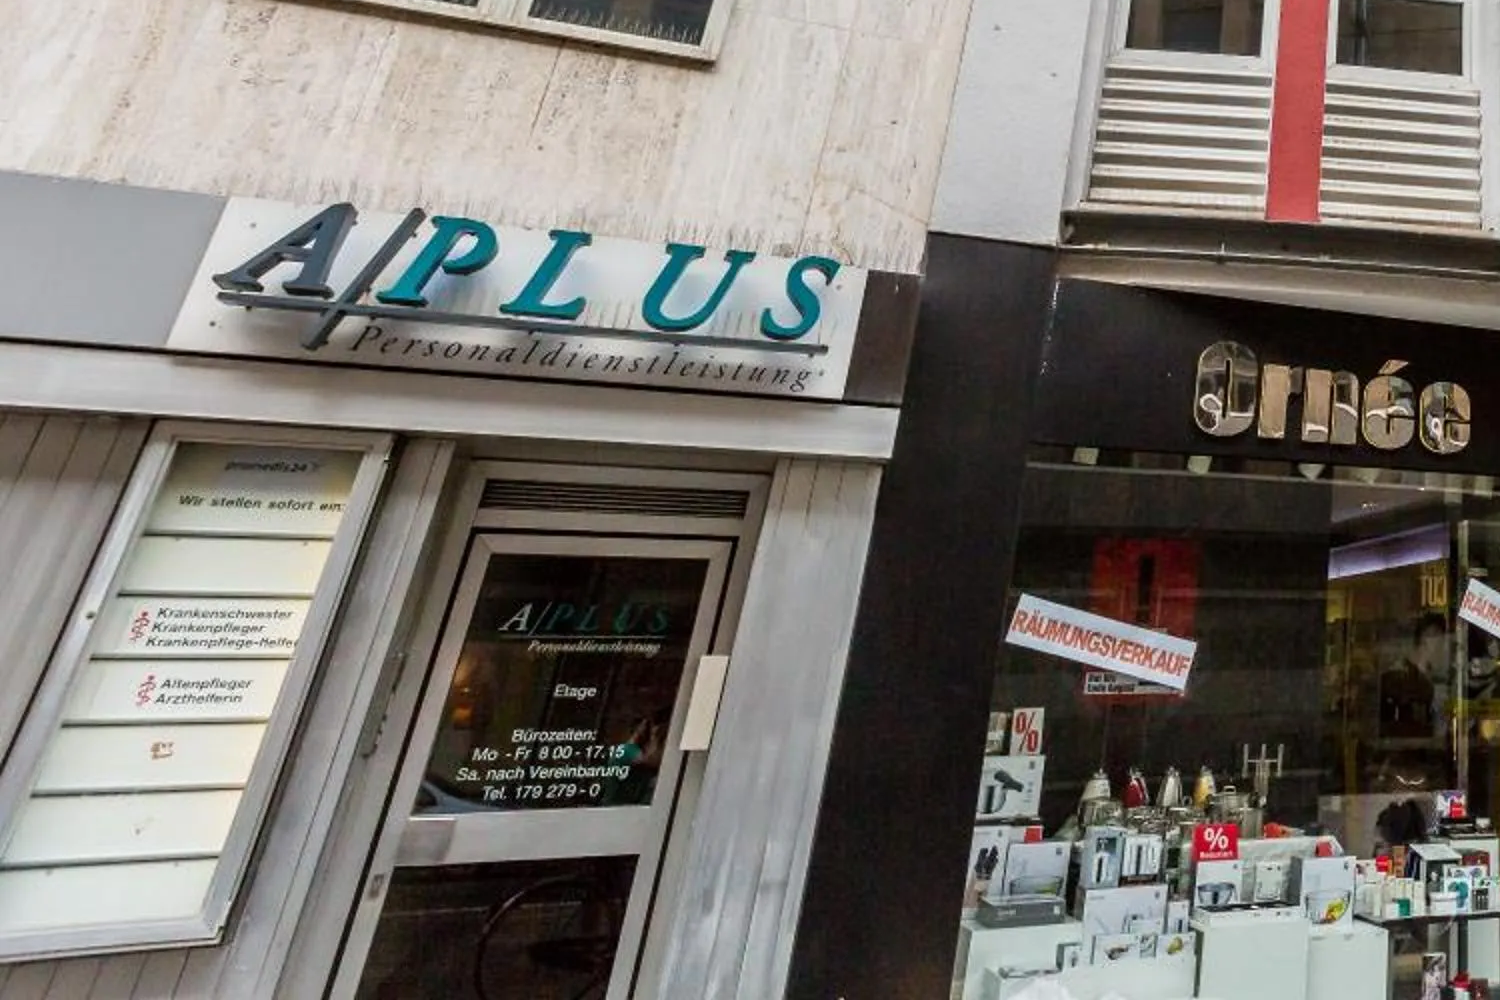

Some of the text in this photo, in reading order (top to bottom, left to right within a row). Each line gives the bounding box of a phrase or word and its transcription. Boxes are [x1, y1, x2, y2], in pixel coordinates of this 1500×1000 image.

[349, 323, 814, 392] Personaldienstleistung
[1193, 340, 1471, 455] Ornée
[179, 494, 203, 506] Wir
[211, 496, 261, 510] stellen
[268, 498, 314, 512] sofort
[157, 607, 295, 620] Krankenschwester
[151, 622, 267, 635] Krankenpfleger
[1011, 606, 1191, 677] RÄUMUNGSVERKAUF
[160, 678, 254, 691] Altenpfleger
[553, 683, 598, 700] Etage
[155, 692, 243, 704] Arzthelferin
[511, 728, 598, 743] Bürozeiten:
[514, 746, 532, 761] Fr
[456, 763, 630, 782] Sa. nach Vereinbarung
[482, 786, 508, 800] Tel.
[515, 784, 542, 800] 179
[545, 783, 577, 799] 279
[1203, 827, 1229, 851] %
